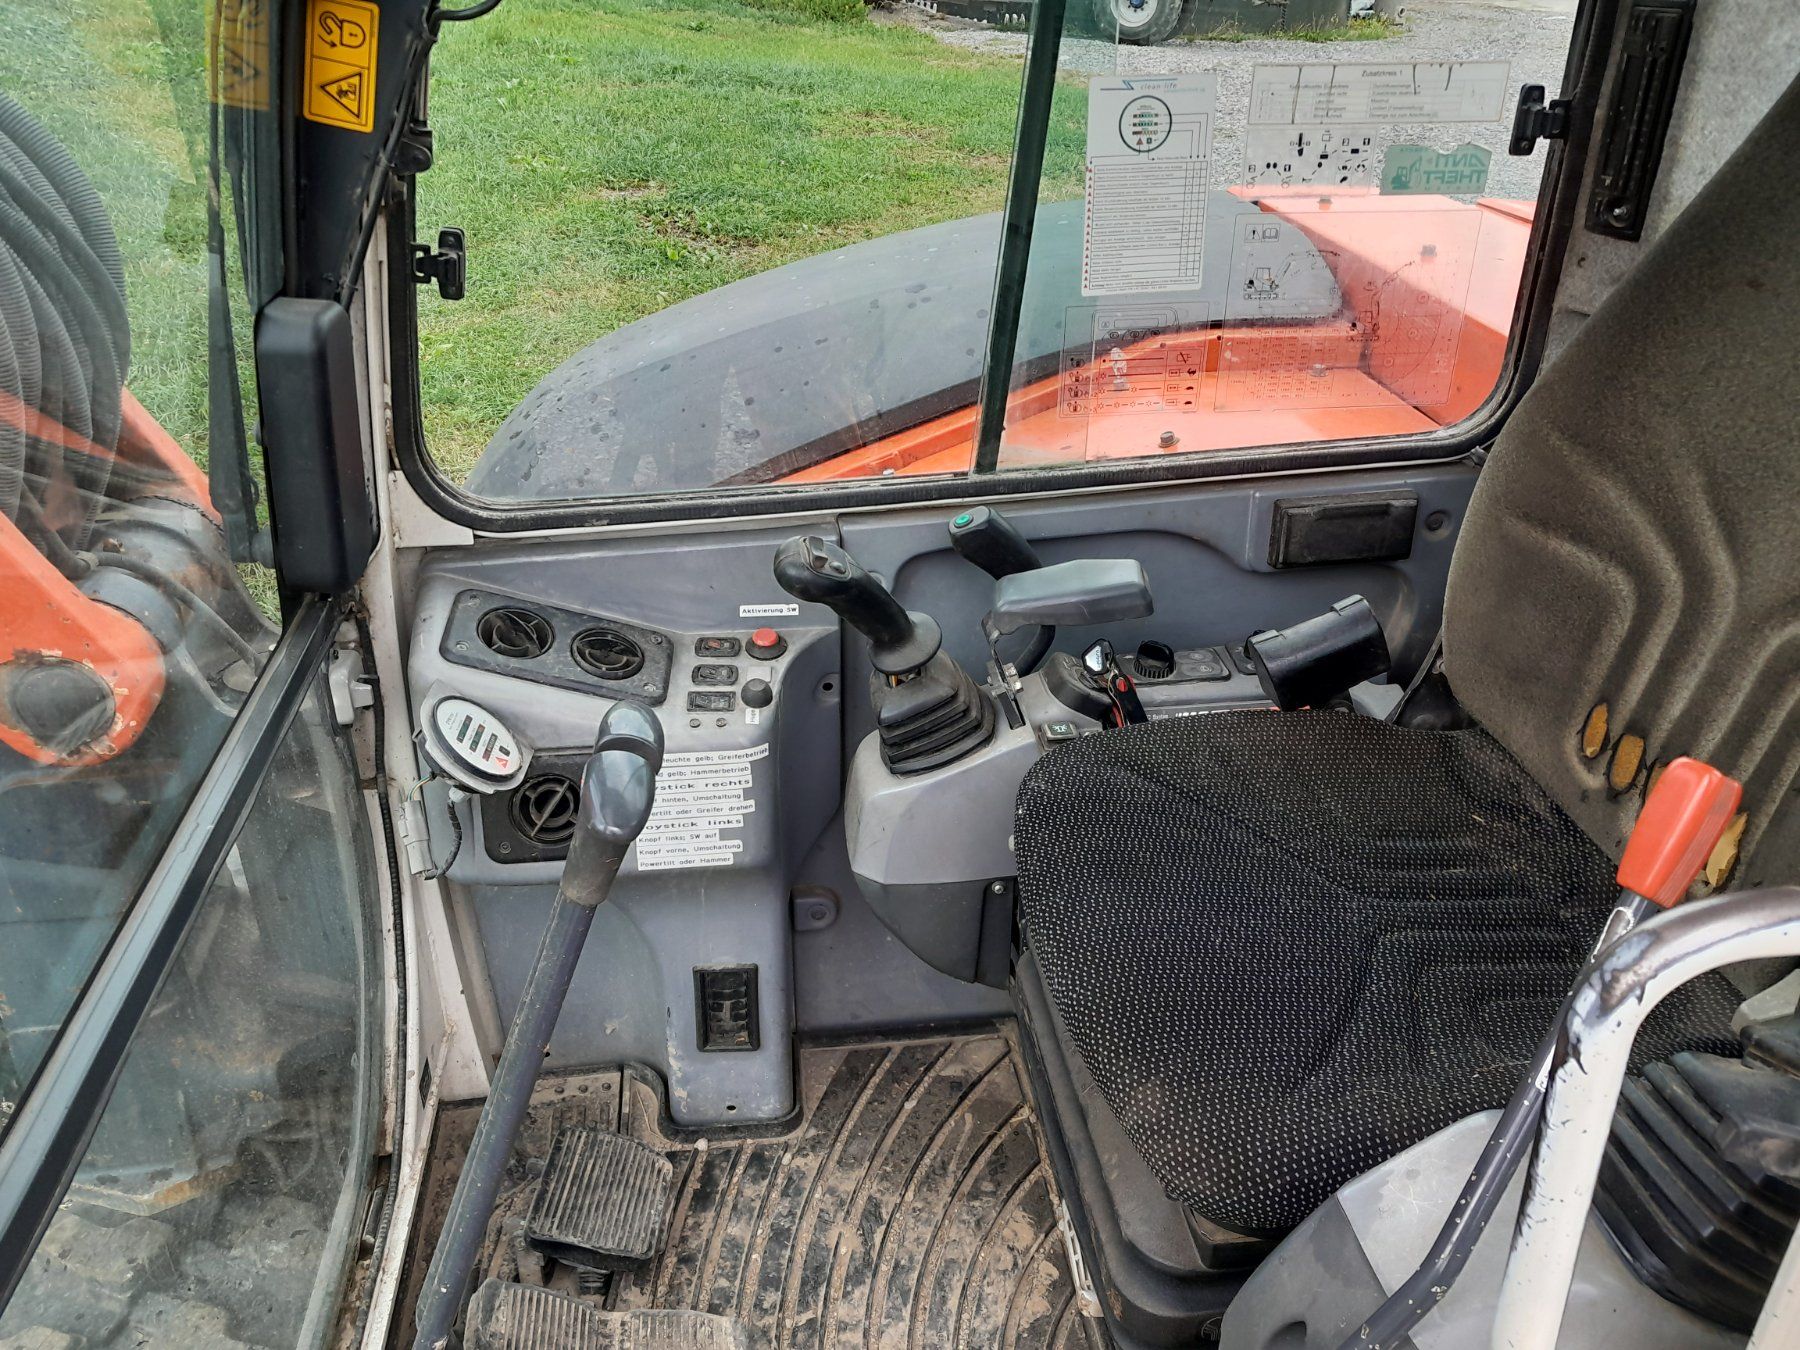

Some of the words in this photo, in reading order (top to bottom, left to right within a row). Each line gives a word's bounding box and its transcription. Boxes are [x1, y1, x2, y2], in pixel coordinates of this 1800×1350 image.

[663, 755, 691, 764] leuchte
[718, 748, 768, 761] Greiferbetrieb
[690, 766, 750, 776] Hammerbetrieb
[655, 783, 696, 792] ystick
[705, 779, 750, 788] rechts
[693, 793, 742, 802] Umschaltung
[697, 806, 724, 815] Greifer
[728, 804, 754, 813] drehen
[645, 821, 699, 831] oystick
[708, 818, 742, 826] links
[638, 836, 661, 844] Knopf
[704, 832, 717, 840] auf
[639, 848, 662, 857] Knopf
[693, 843, 741, 852] Umschaltung
[640, 859, 676, 868] Powertilt
[700, 856, 732, 864] Hammer
